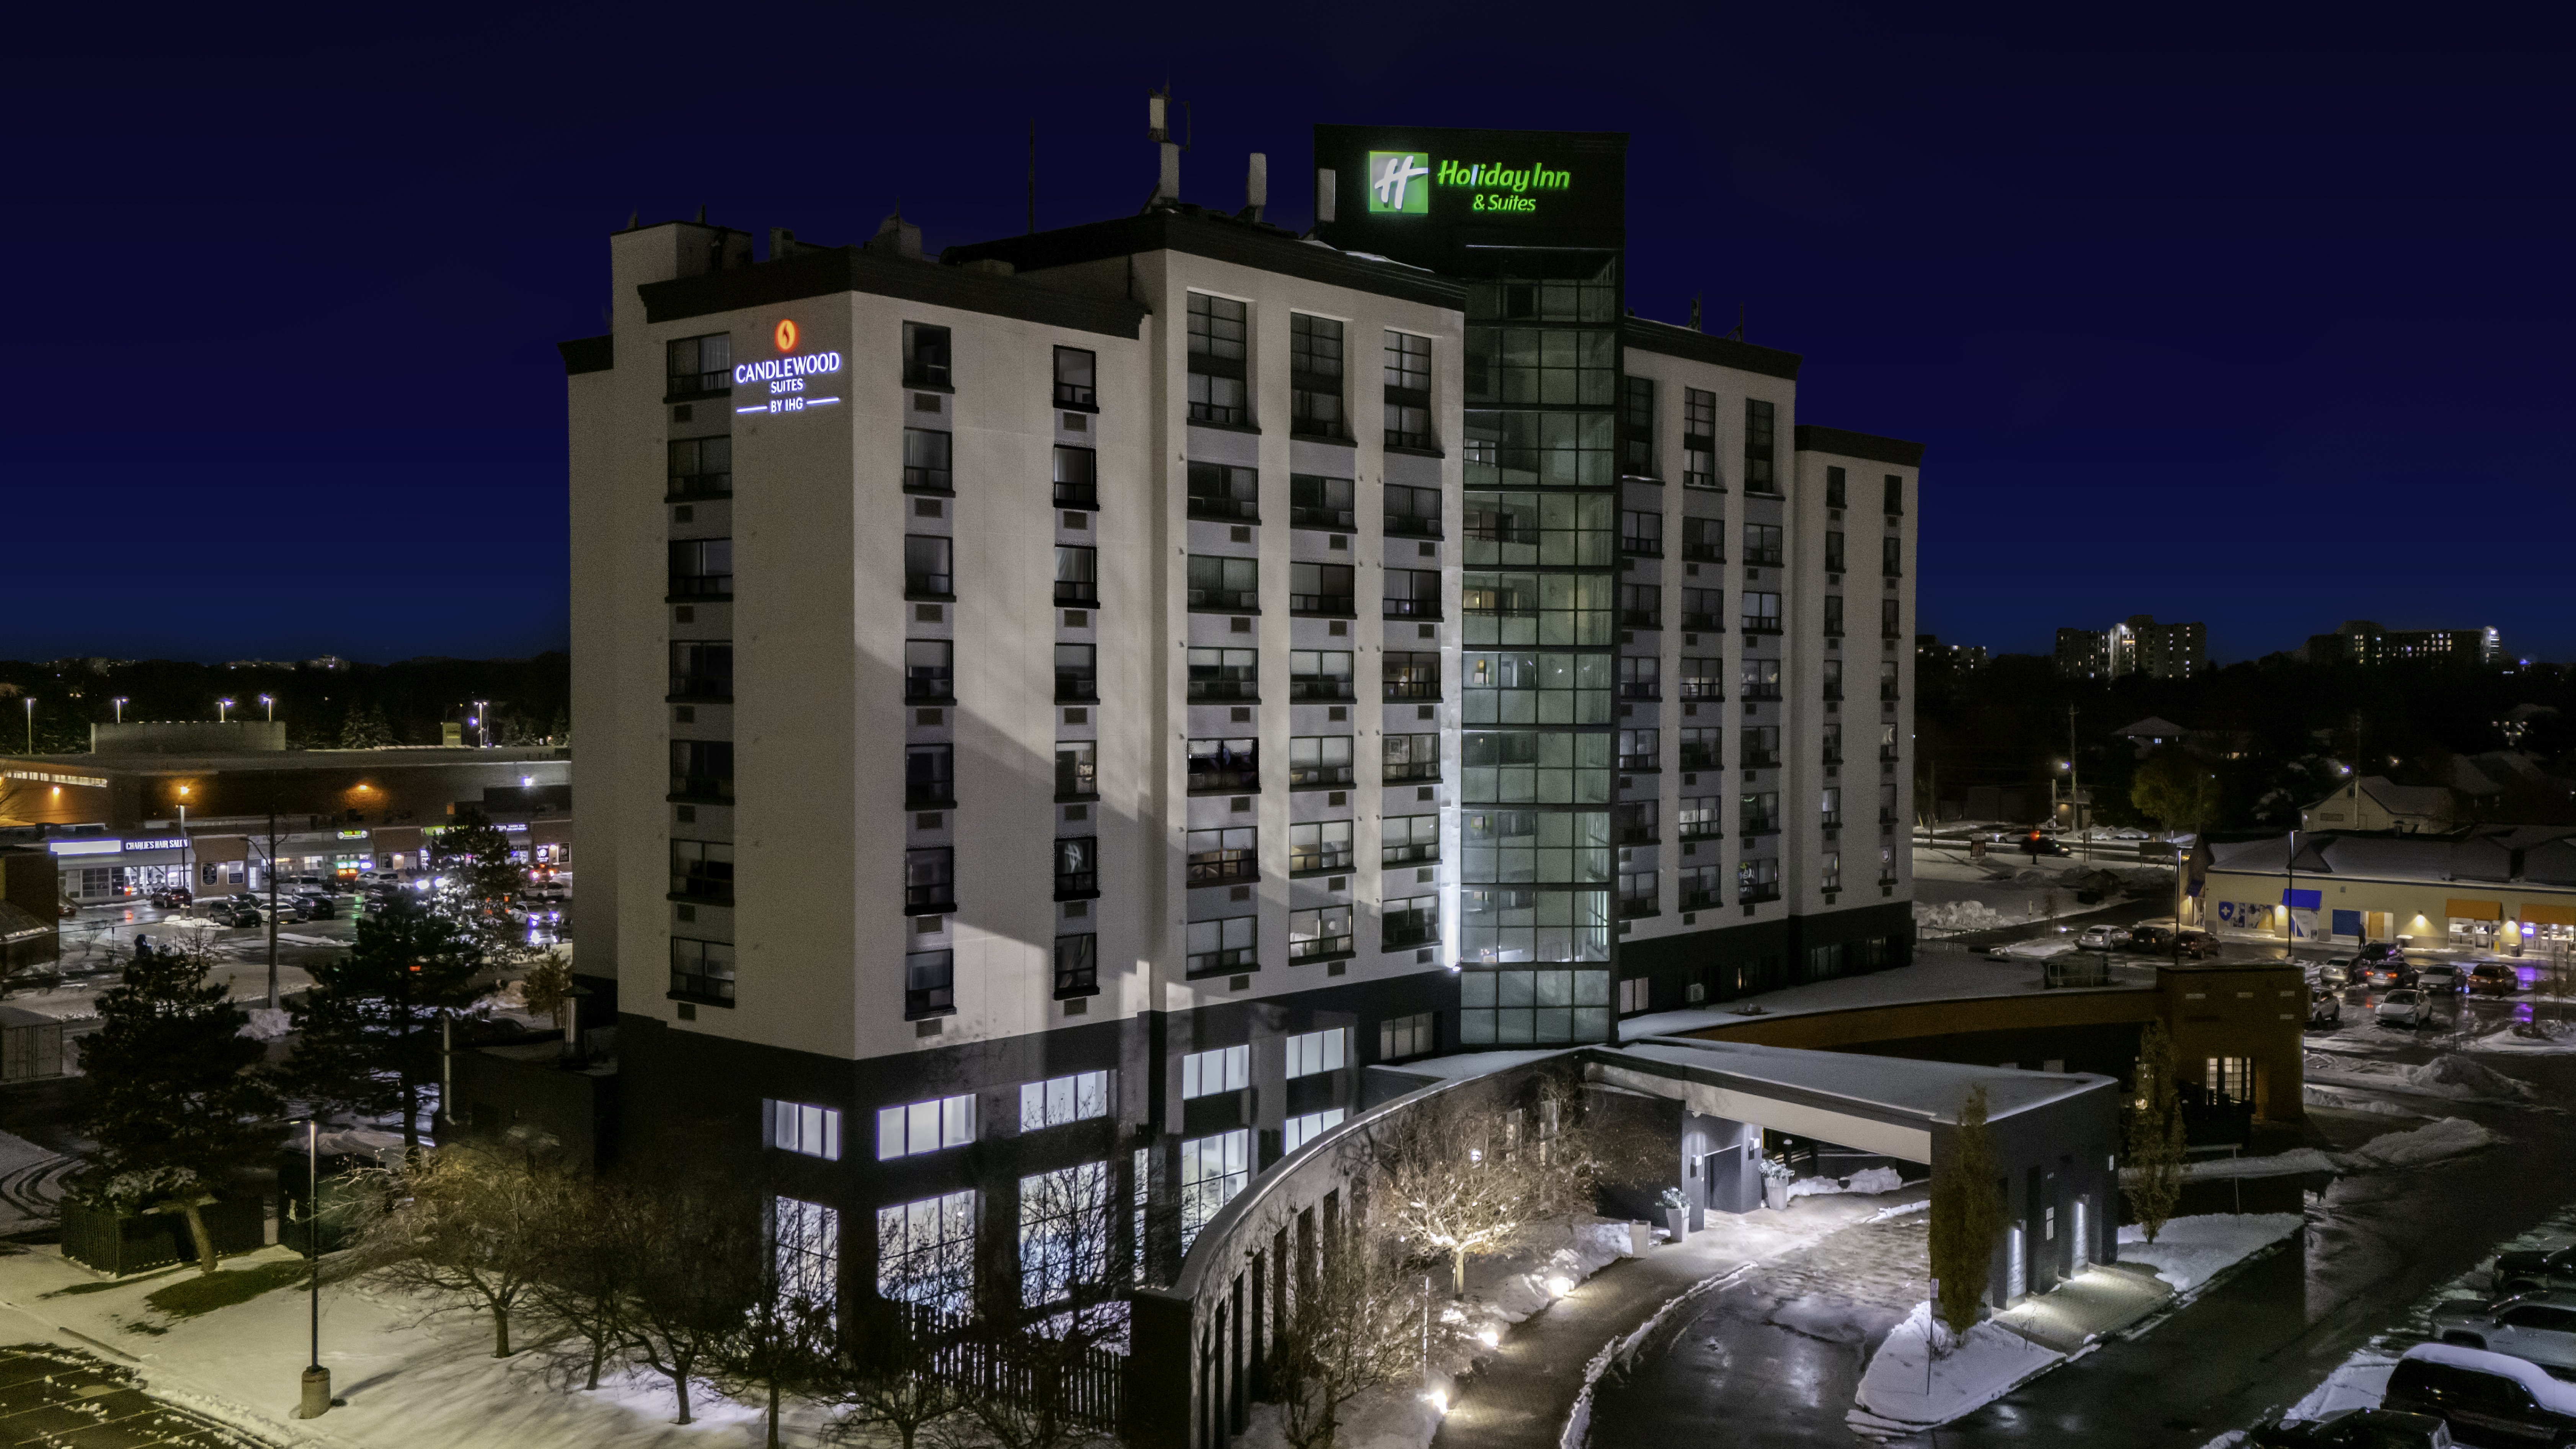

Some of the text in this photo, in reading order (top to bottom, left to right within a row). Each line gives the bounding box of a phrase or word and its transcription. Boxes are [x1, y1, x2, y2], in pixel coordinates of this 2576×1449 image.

[1438, 160, 1570, 192] Holiday Inn
[1473, 194, 1536, 211] & Suites
[736, 352, 839, 383] CANDLEWOOD
[771, 378, 803, 393] SUITES
[771, 398, 803, 413] BY IHG
[155, 840, 168, 849] HAIR
